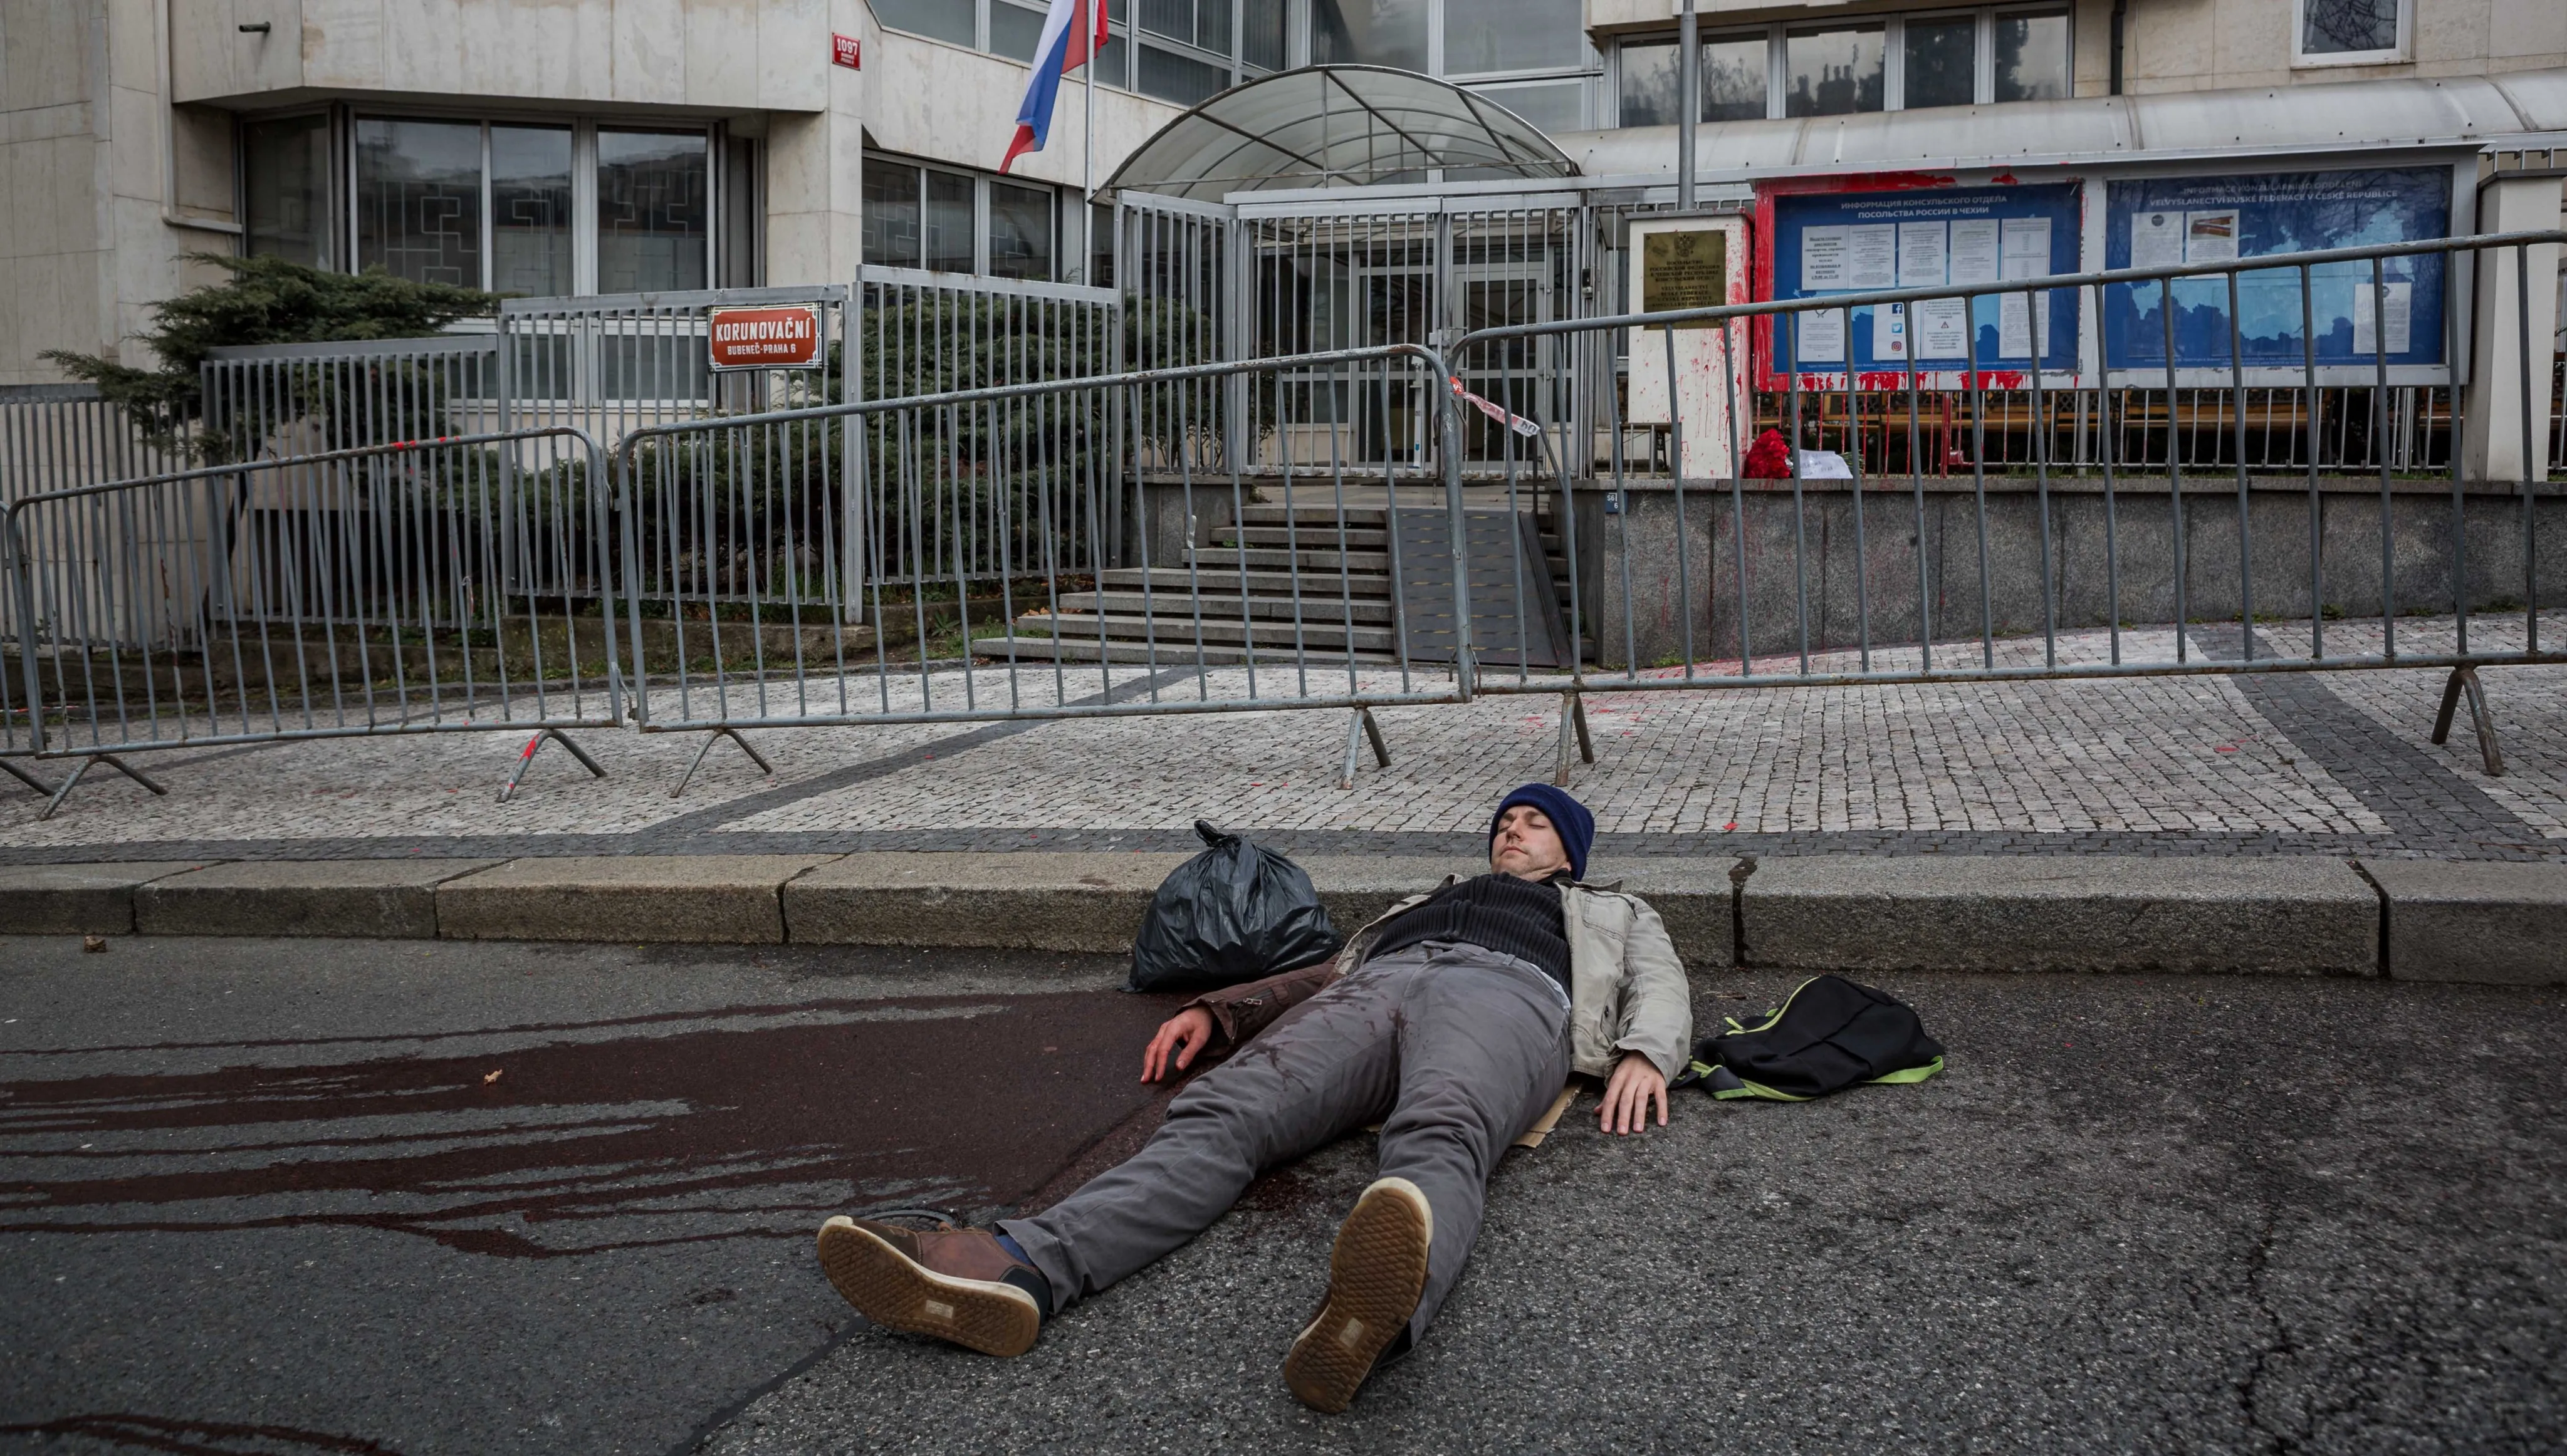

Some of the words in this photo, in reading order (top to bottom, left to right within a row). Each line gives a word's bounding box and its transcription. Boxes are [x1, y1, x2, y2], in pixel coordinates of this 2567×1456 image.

[837, 38, 858, 56] 1097
[1841, 200, 1902, 210] ИНФОРМАЦИЯ
[1903, 197, 1970, 207] КОНСУЛЬСКОГО
[1972, 195, 2007, 204] ОТДЕЛА
[2150, 195, 2225, 206] VELVYSLANECTVÍ
[2226, 194, 2257, 204] RUSKÉ
[2258, 194, 2305, 202] FEDERACE
[2315, 190, 2345, 200] ČESKÉ
[2346, 190, 2398, 199] REPUBLICE
[1858, 209, 1915, 219] ПОСОЛЬСТВА
[1916, 208, 1950, 216] РОССИИ
[1960, 206, 1989, 214] ЧЕХИИ
[716, 316, 810, 341] KORUNOVAČNÍ
[790, 343, 797, 353] 6
